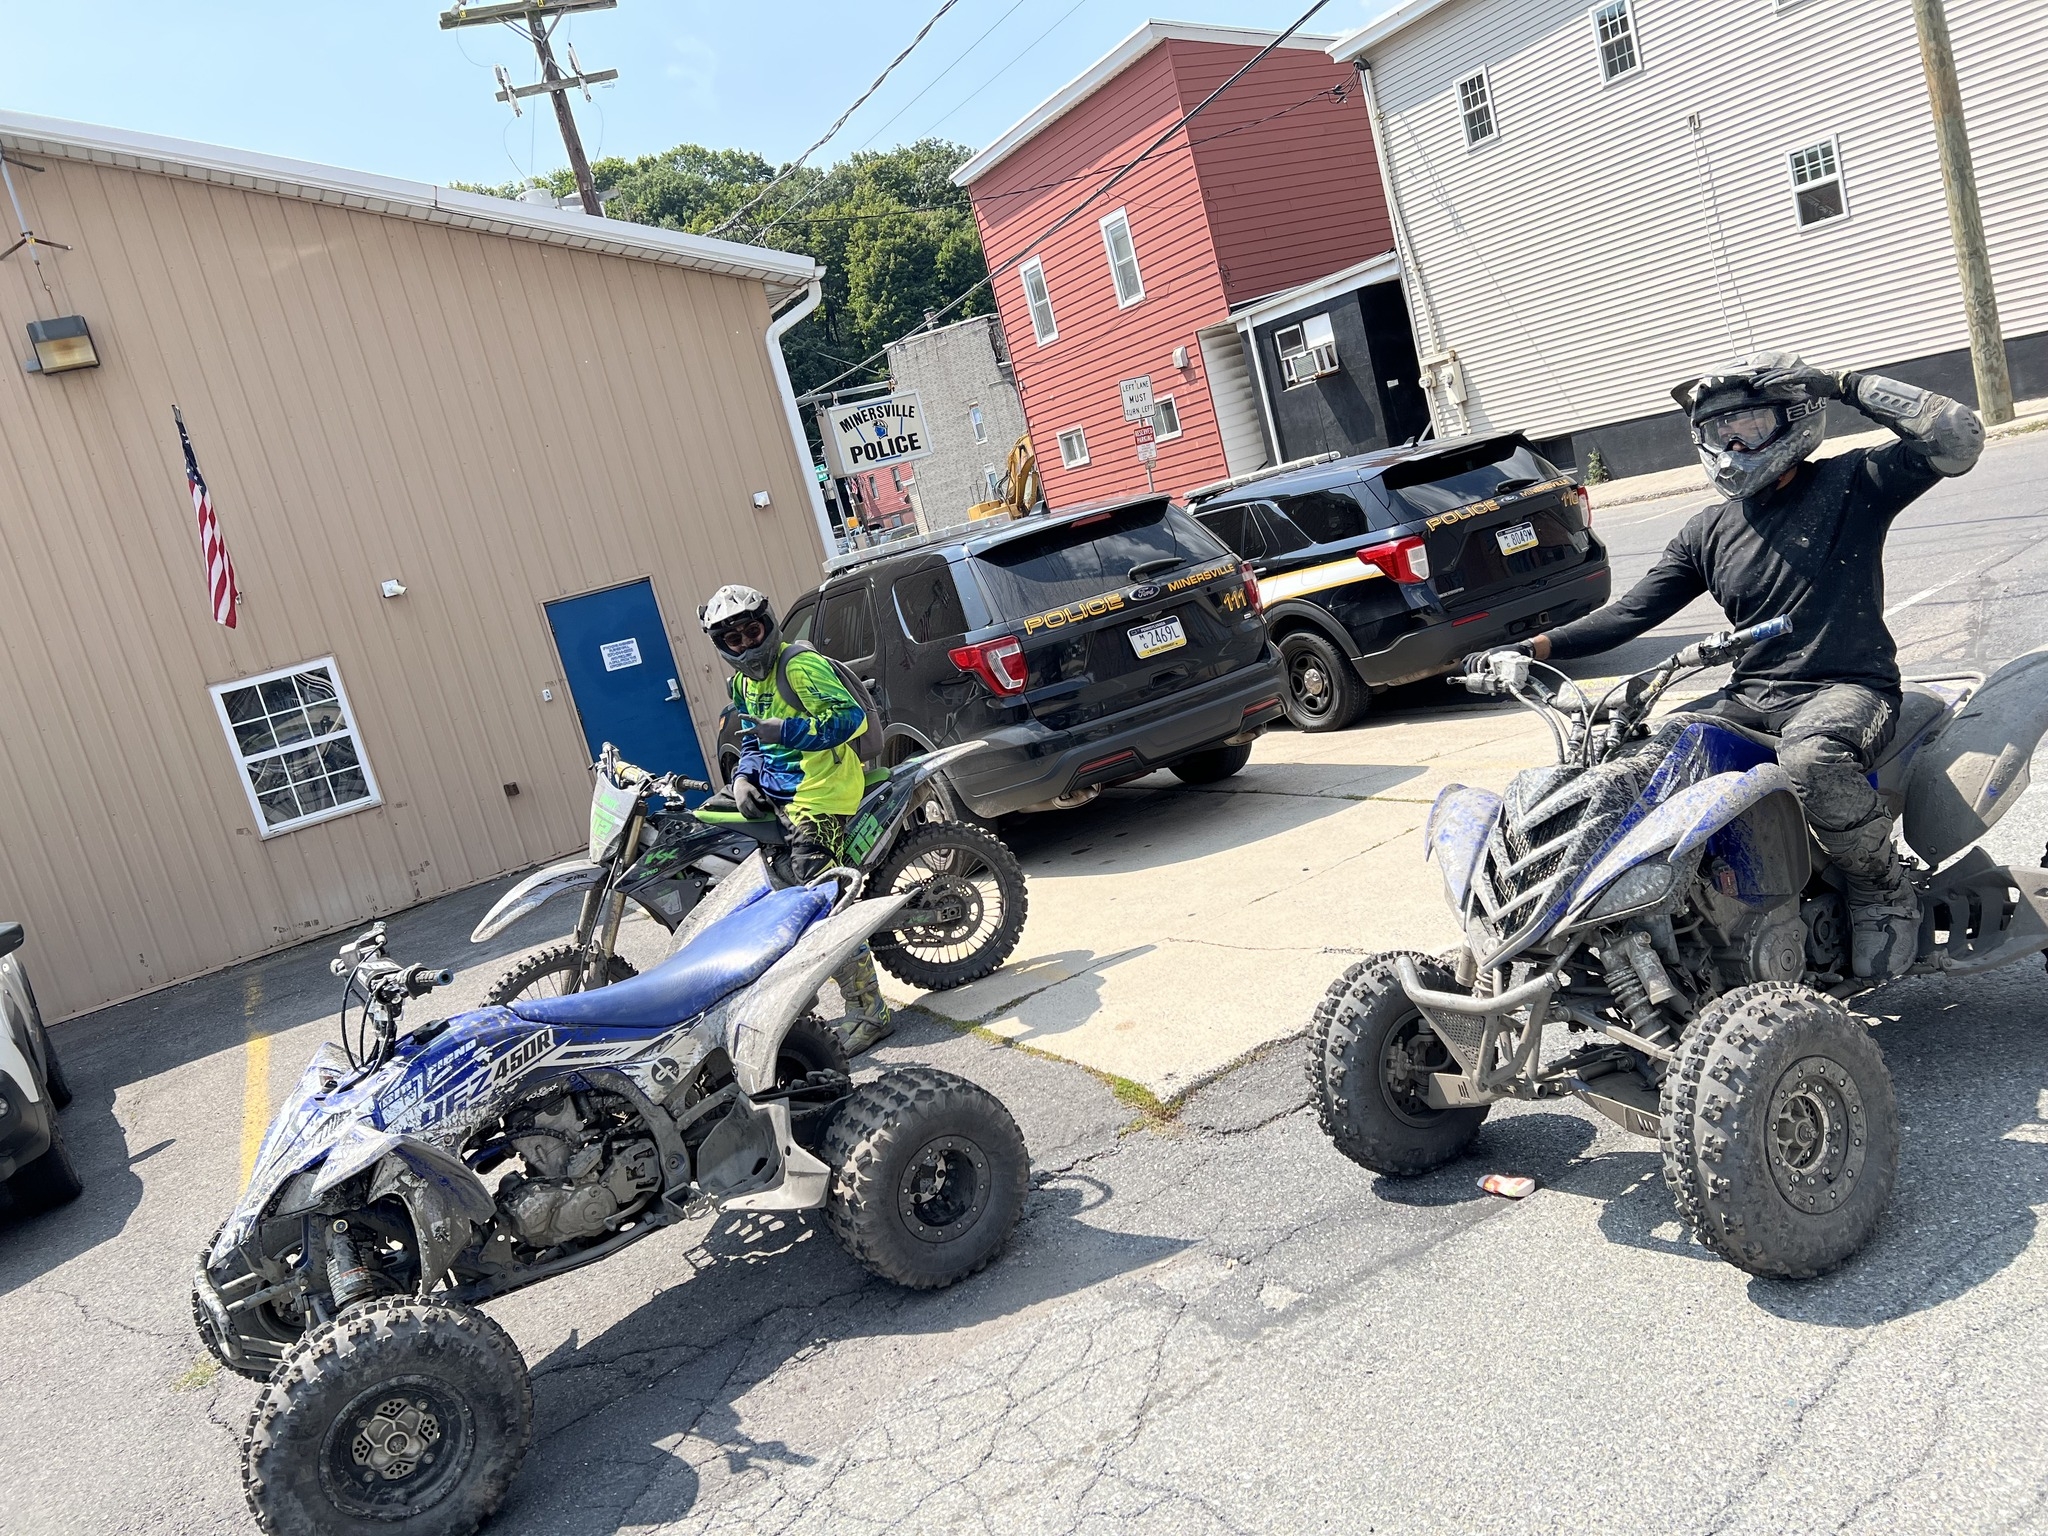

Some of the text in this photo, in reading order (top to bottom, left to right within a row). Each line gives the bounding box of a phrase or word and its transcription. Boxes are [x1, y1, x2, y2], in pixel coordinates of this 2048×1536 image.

[1122, 380, 1149, 393] LEFT LANE
[1129, 393, 1147, 404] MUST
[839, 404, 915, 433] MINERSVILLE
[1126, 405, 1153, 416] TURN LEFT
[849, 432, 922, 464] POLICE
[1519, 478, 1570, 498] MINERSVILLE
[1425, 499, 1501, 532] POLICE
[1167, 563, 1236, 592] MINERSVILLE
[1223, 588, 1248, 612] 111
[1023, 593, 1125, 636] POLICE
[1147, 625, 1180, 647] 2469L
[493, 1028, 552, 1082] 450R
